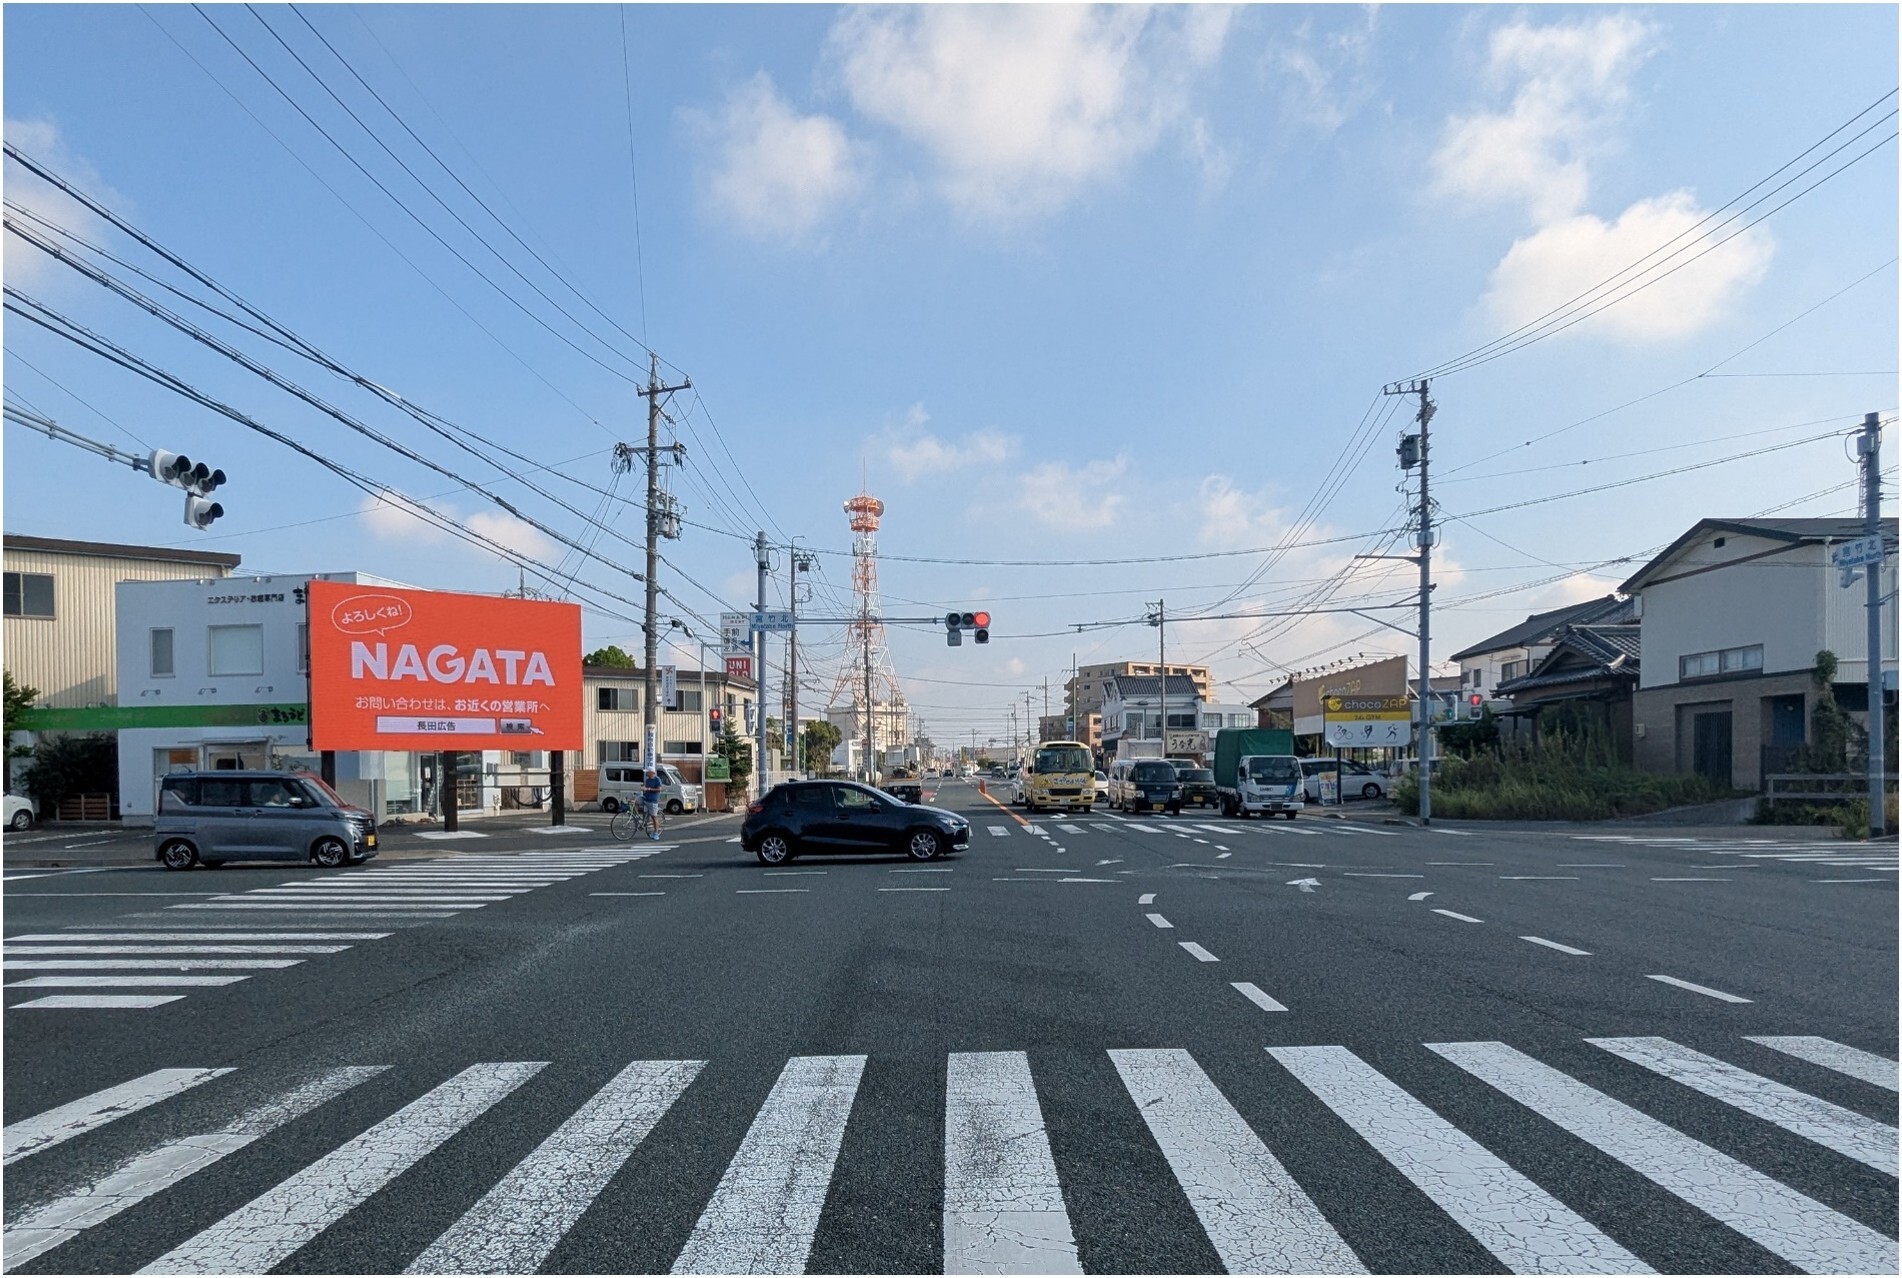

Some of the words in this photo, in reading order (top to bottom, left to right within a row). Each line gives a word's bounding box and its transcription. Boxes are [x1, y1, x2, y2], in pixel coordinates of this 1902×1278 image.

[755, 614, 789, 624] 宮竹北
[351, 641, 556, 687] NAGATA
[729, 660, 747, 670] UNI
[355, 695, 552, 714] お問い合わせは、お近くの営業所へ
[1344, 698, 1407, 710] chocoZAP
[417, 720, 457, 732] 長田広告
